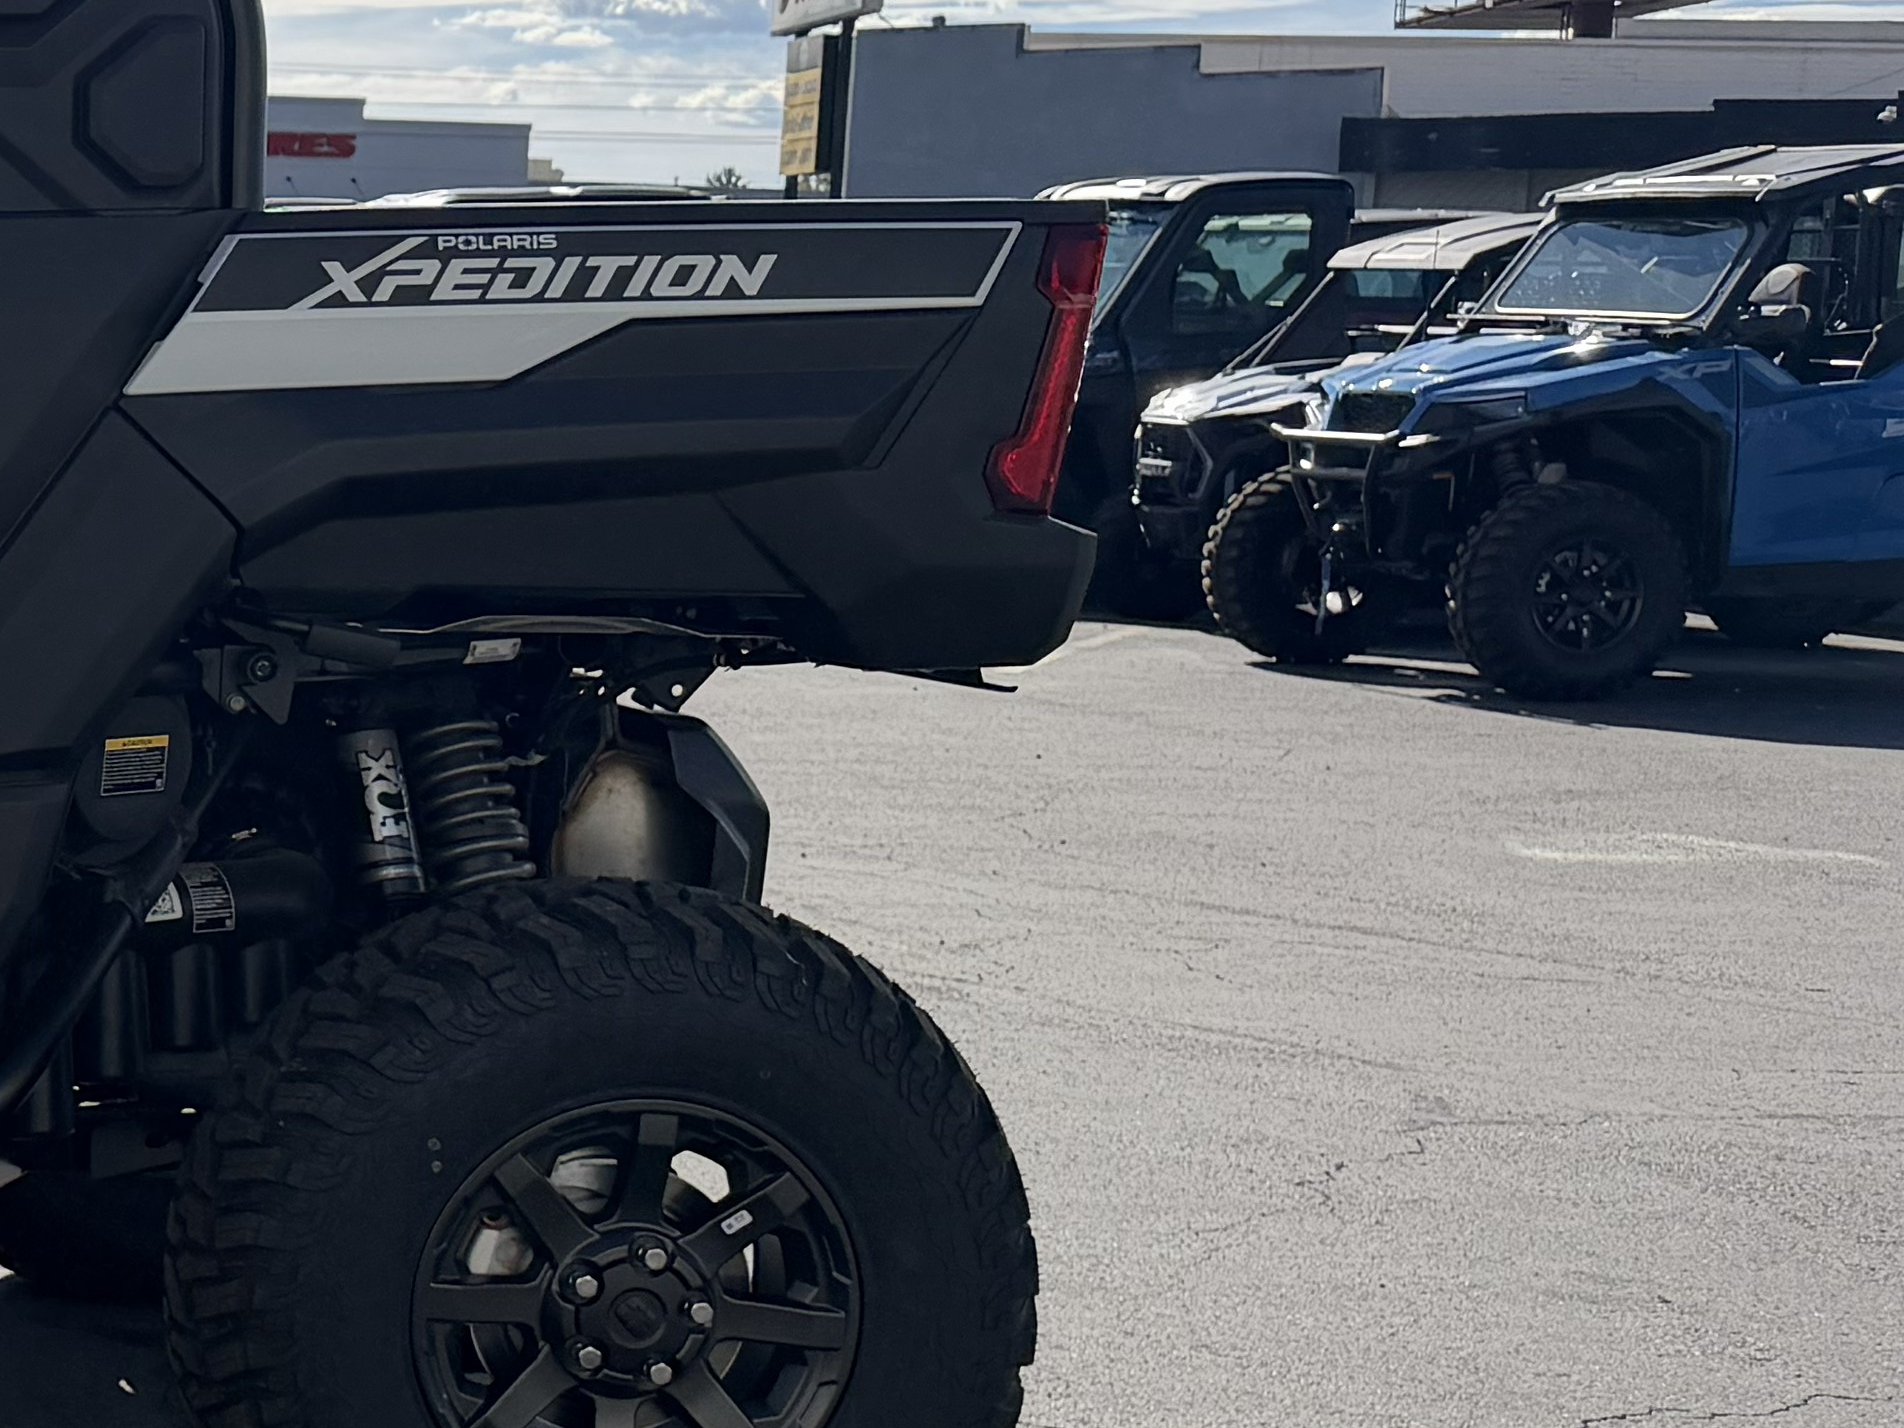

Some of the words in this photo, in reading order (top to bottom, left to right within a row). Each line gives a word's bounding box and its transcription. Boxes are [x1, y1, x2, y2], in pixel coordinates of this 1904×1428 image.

[287, 236, 778, 309] XPEDITION
[437, 234, 558, 251] POLARIS
[357, 749, 409, 842] FOX
